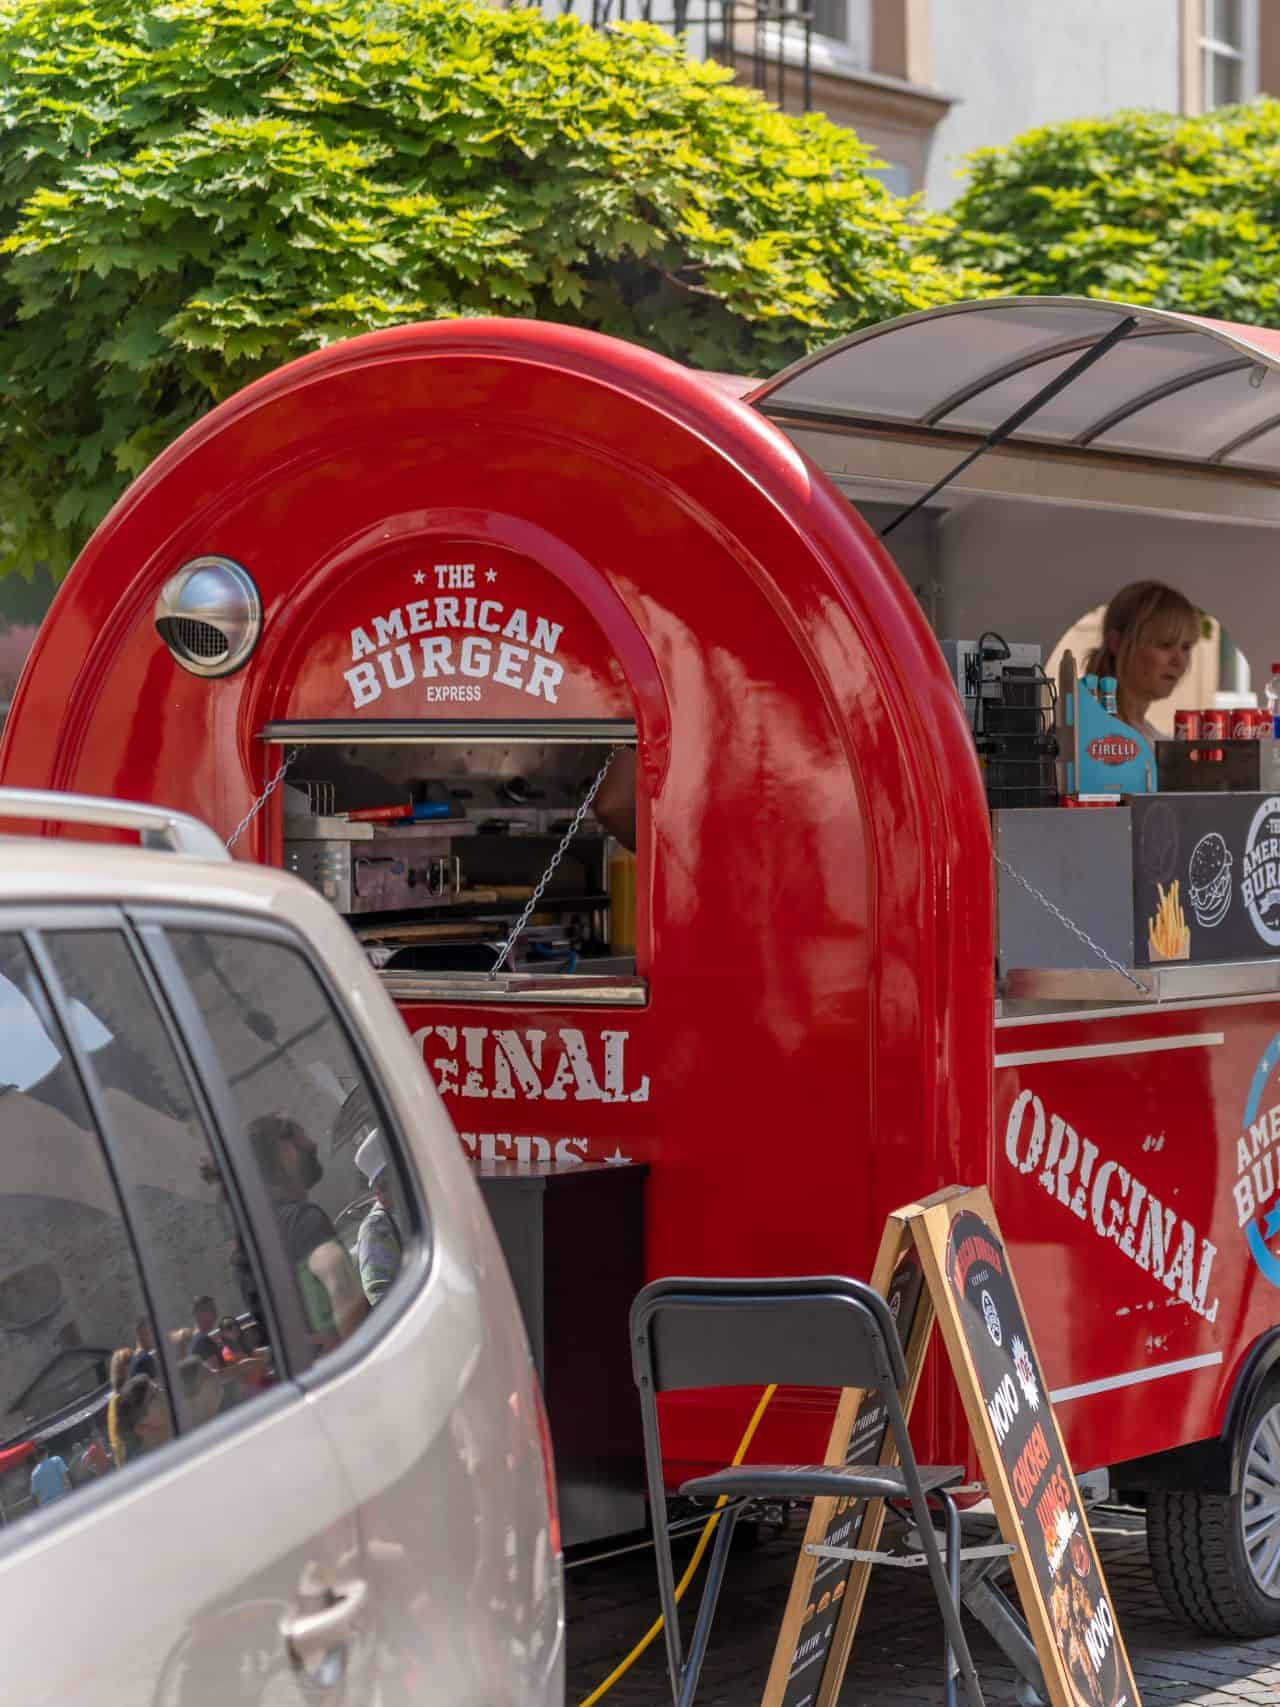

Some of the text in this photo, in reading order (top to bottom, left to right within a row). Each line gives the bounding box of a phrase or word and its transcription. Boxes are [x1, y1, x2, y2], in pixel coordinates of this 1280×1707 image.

[434, 564, 475, 589] THE
[350, 597, 564, 661] AMERICAN
[343, 636, 564, 709] BURGER
[427, 686, 481, 702] EXPRESS
[411, 1025, 650, 1104] GINAL
[1004, 1088, 1219, 1324] ORIGINAL
[987, 1373, 1020, 1447] NOVO
[1012, 1421, 1051, 1509] CHICKEN
[1085, 1597, 1115, 1673] NOVO
